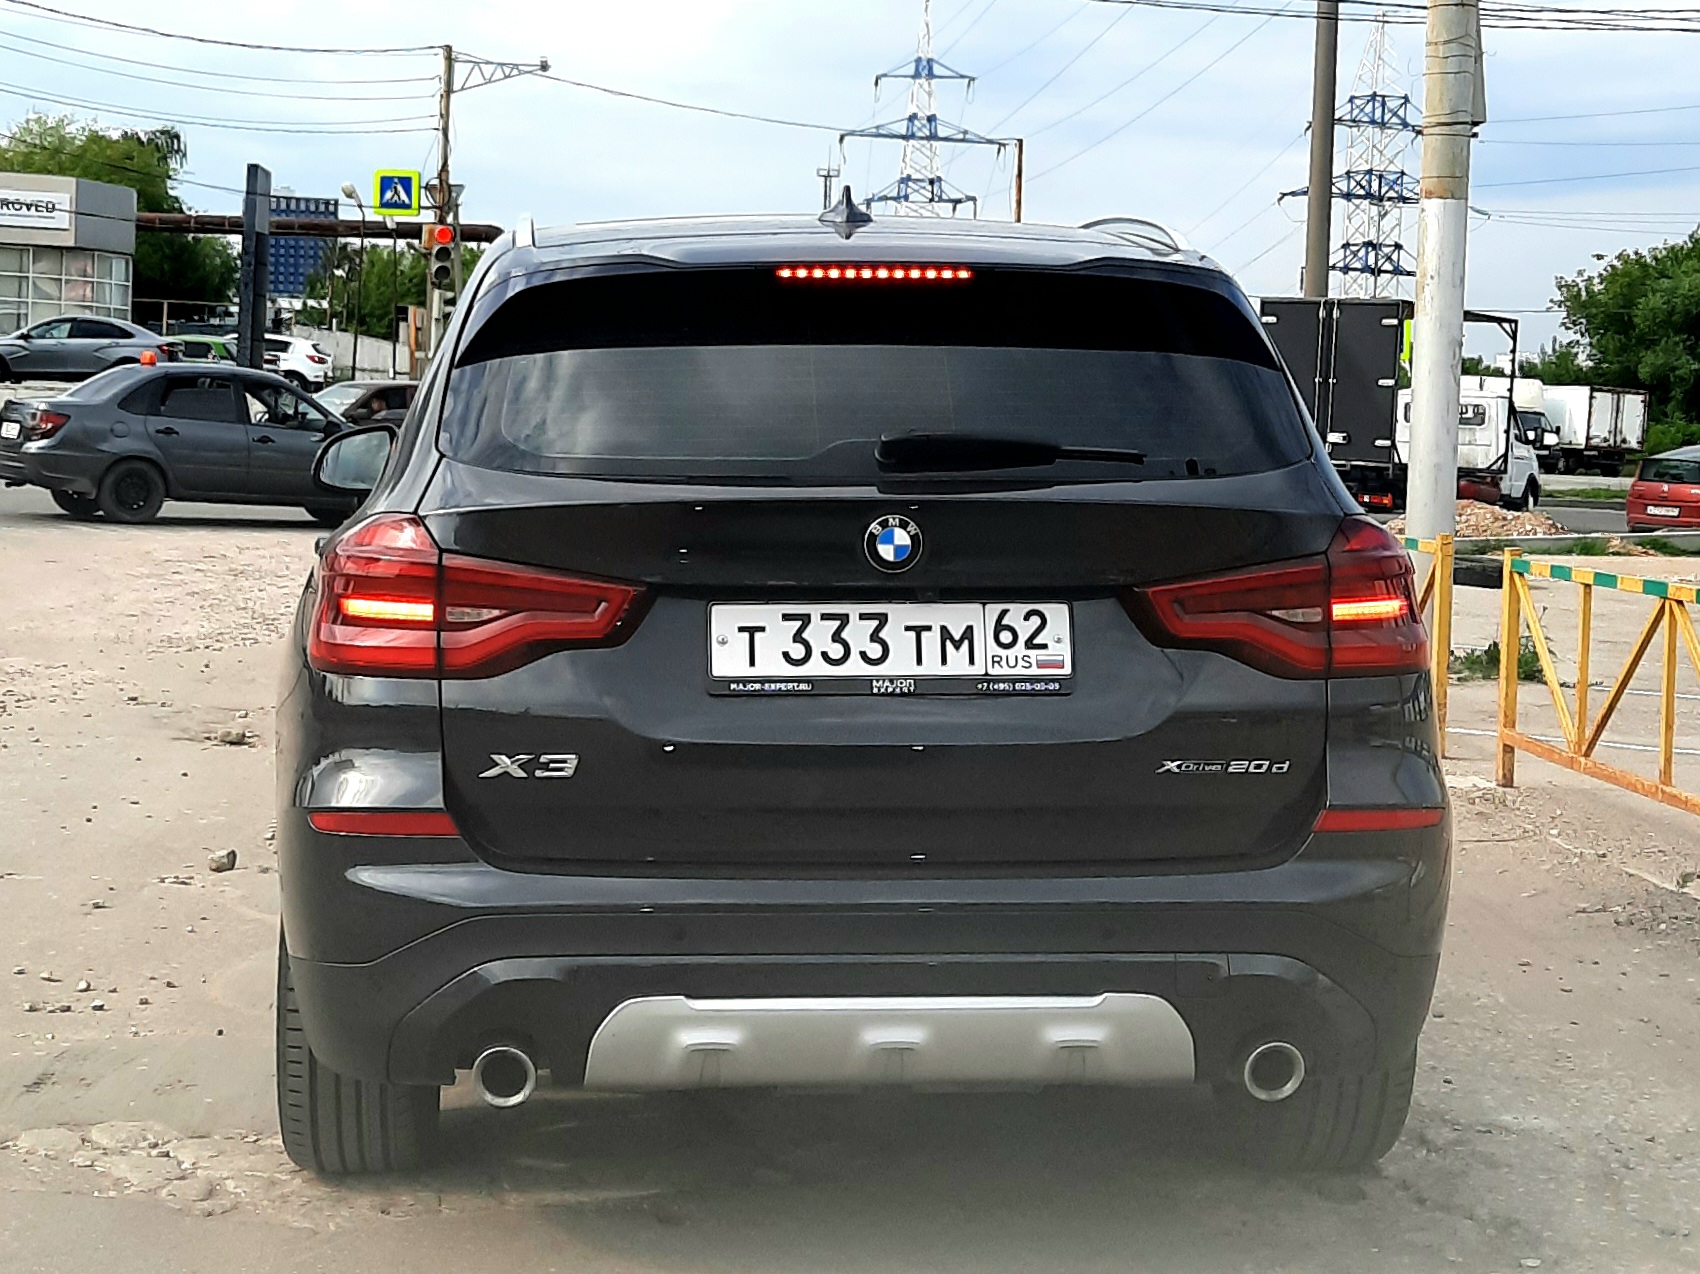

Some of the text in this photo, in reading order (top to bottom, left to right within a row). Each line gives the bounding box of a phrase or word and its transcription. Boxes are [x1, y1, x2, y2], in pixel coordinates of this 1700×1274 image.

[871, 517, 919, 535] BMW
[993, 608, 1048, 651] 62
[991, 654, 1033, 669] RUS
[872, 679, 914, 687] MAJOR
[478, 754, 579, 777] X3
